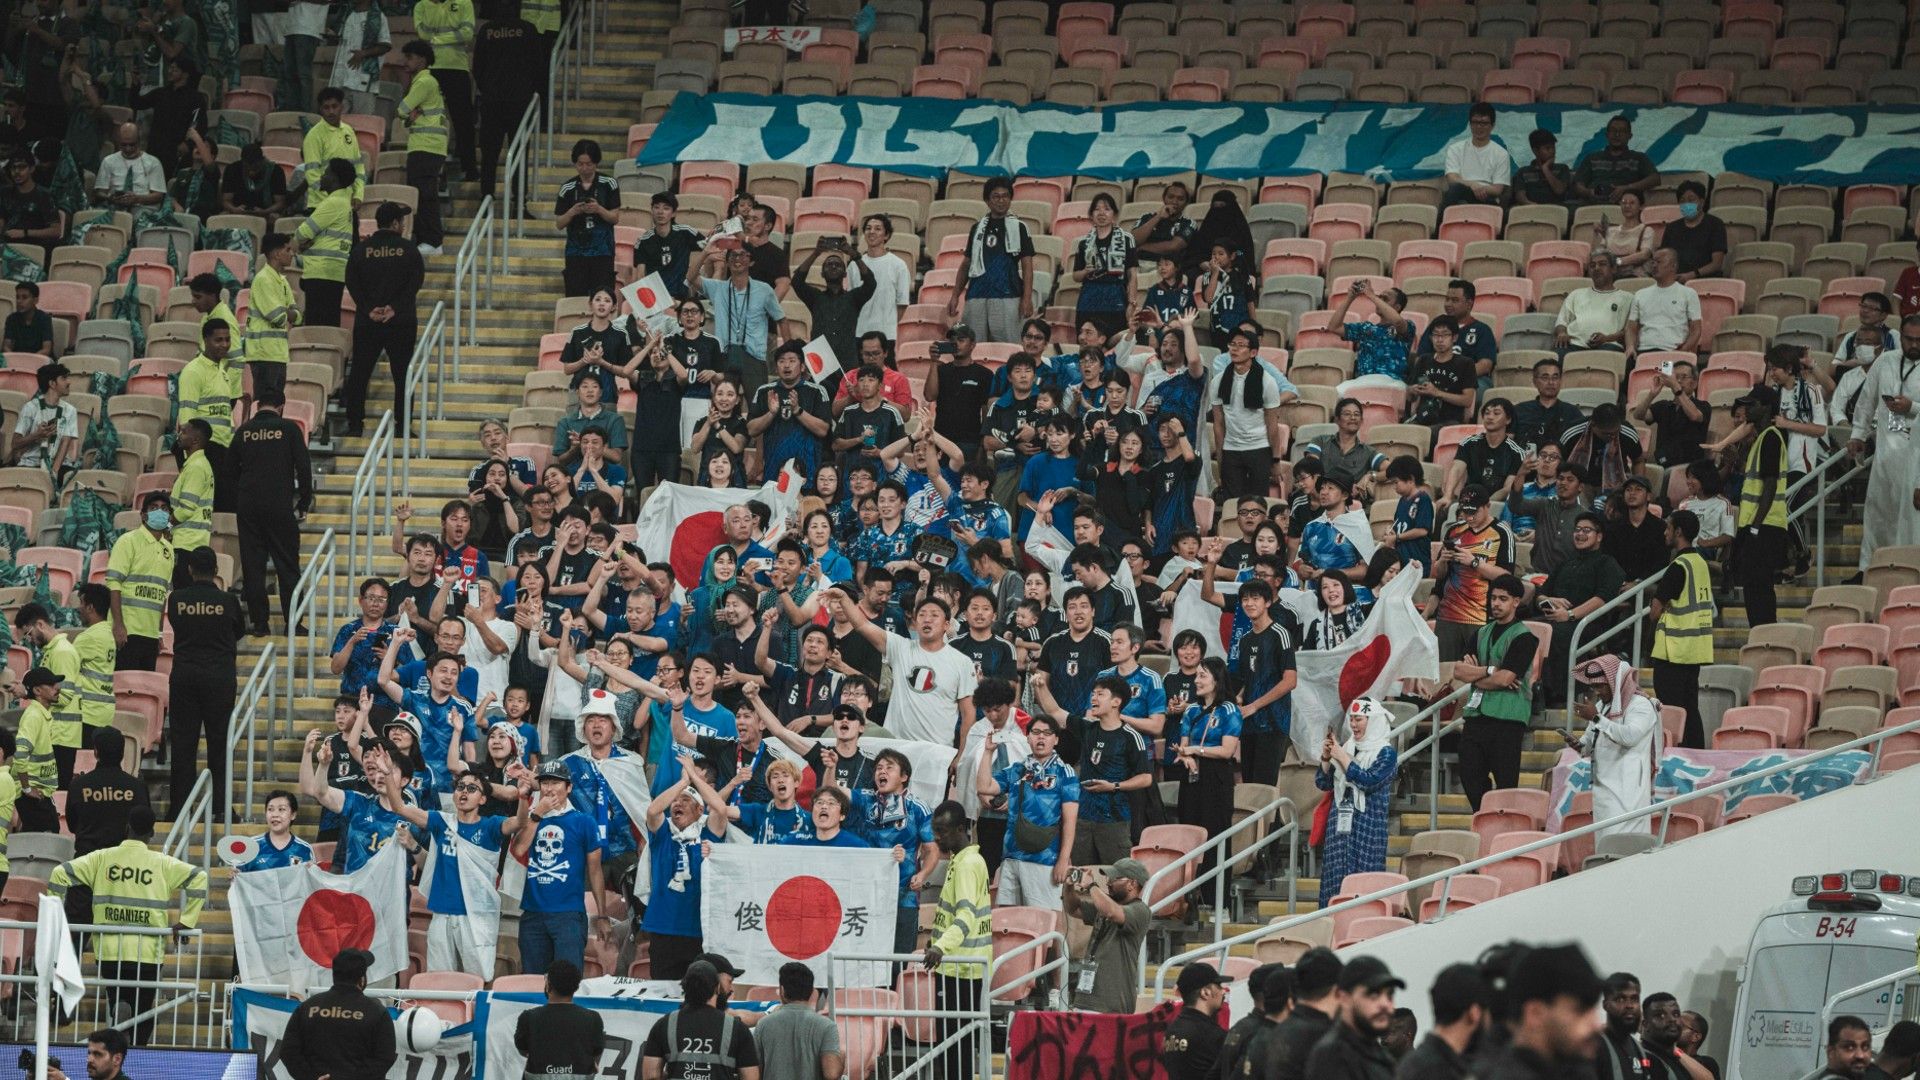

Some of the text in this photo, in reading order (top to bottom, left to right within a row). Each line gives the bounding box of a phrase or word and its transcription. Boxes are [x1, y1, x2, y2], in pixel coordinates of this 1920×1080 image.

[486, 27, 523, 40] Police
[365, 246, 404, 258] Police
[1222, 295, 1234, 310] 17
[243, 429, 283, 442] Police
[177, 601, 224, 615] Police
[82, 786, 134, 802] Police
[107, 865, 153, 886] EPIC
[105, 907, 151, 924] ORGANIZER
[735, 901, 869, 937] 俊 秀
[1816, 917, 1857, 938] B-54
[308, 1006, 364, 1020] Police
[682, 1037, 713, 1054] 225
[546, 1064, 573, 1074] Guard
